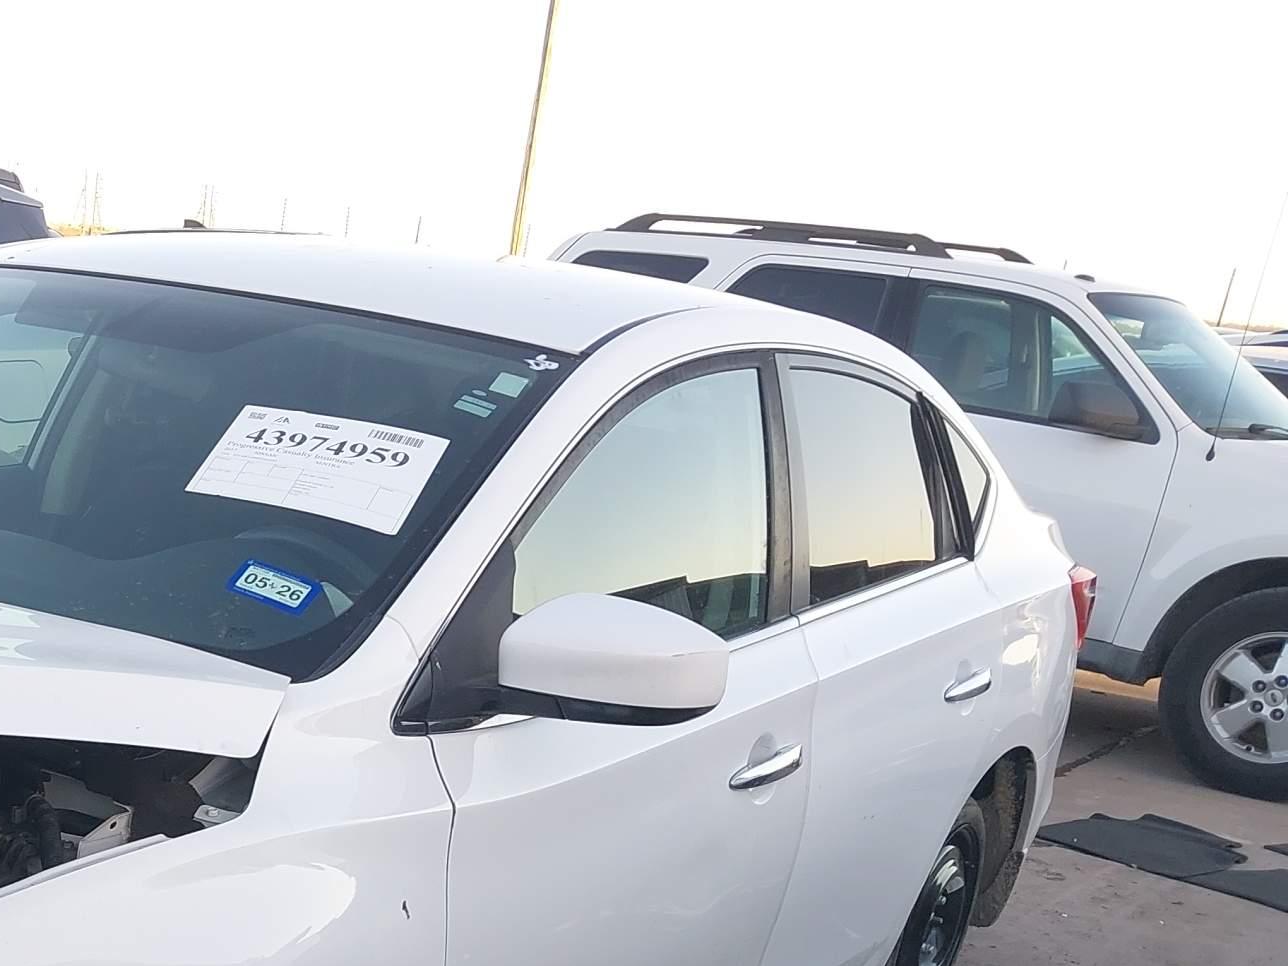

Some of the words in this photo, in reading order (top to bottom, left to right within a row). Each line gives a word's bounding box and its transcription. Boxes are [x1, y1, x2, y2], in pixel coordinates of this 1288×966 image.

[245, 428, 411, 468] 43974959
[244, 572, 270, 589] 05
[275, 584, 304, 601] 26
